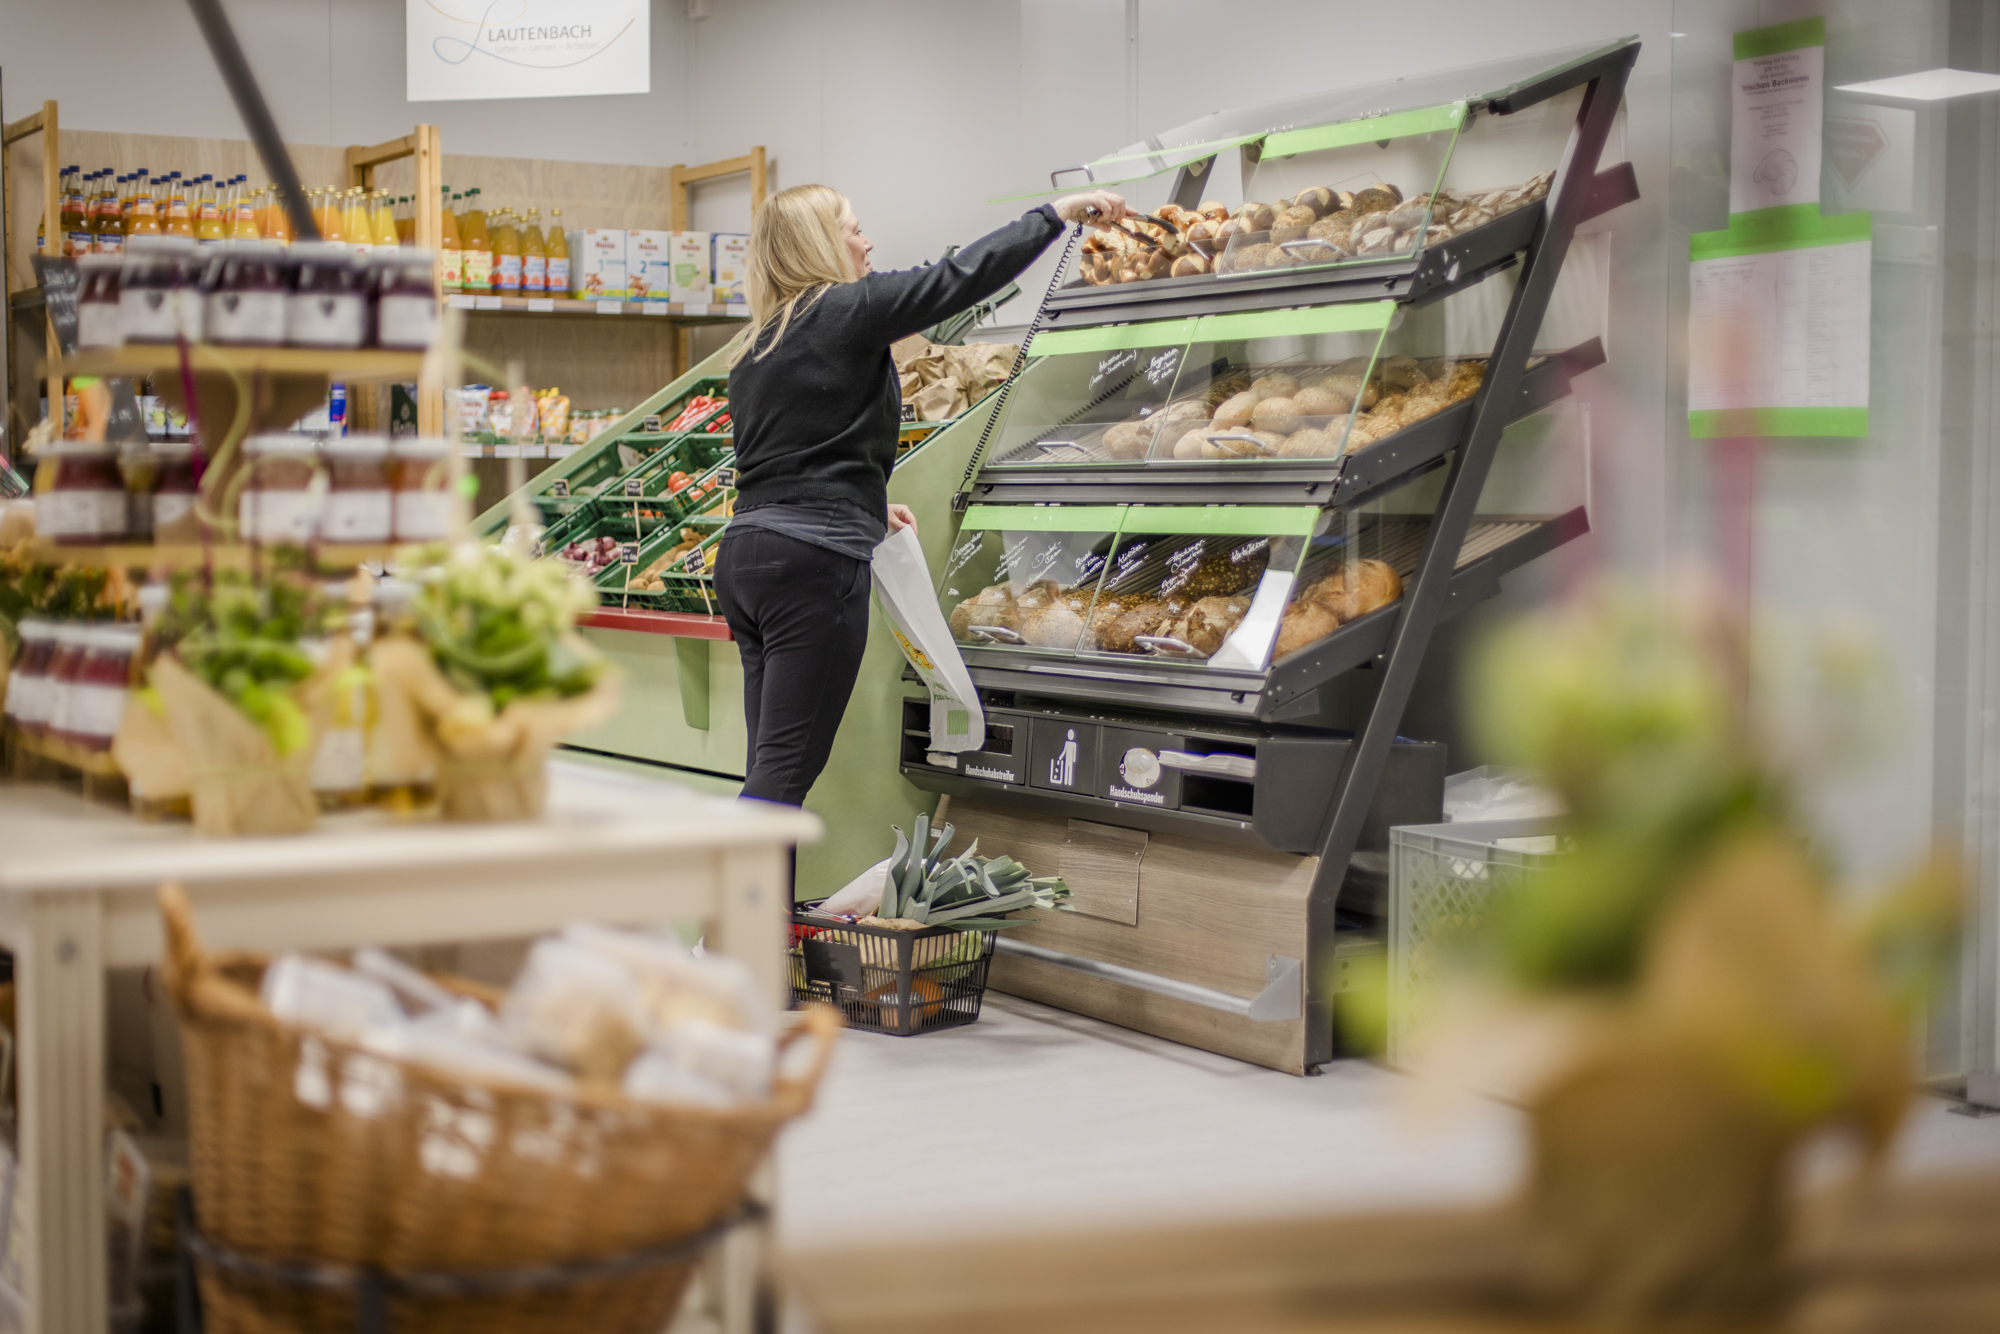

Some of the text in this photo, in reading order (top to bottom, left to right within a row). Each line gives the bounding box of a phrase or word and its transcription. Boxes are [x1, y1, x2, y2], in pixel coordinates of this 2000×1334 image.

[488, 25, 592, 42] LAUTENBACH
[965, 764, 1015, 782] Handschuhabstreifer
[1109, 785, 1164, 804] Handschuhspender
